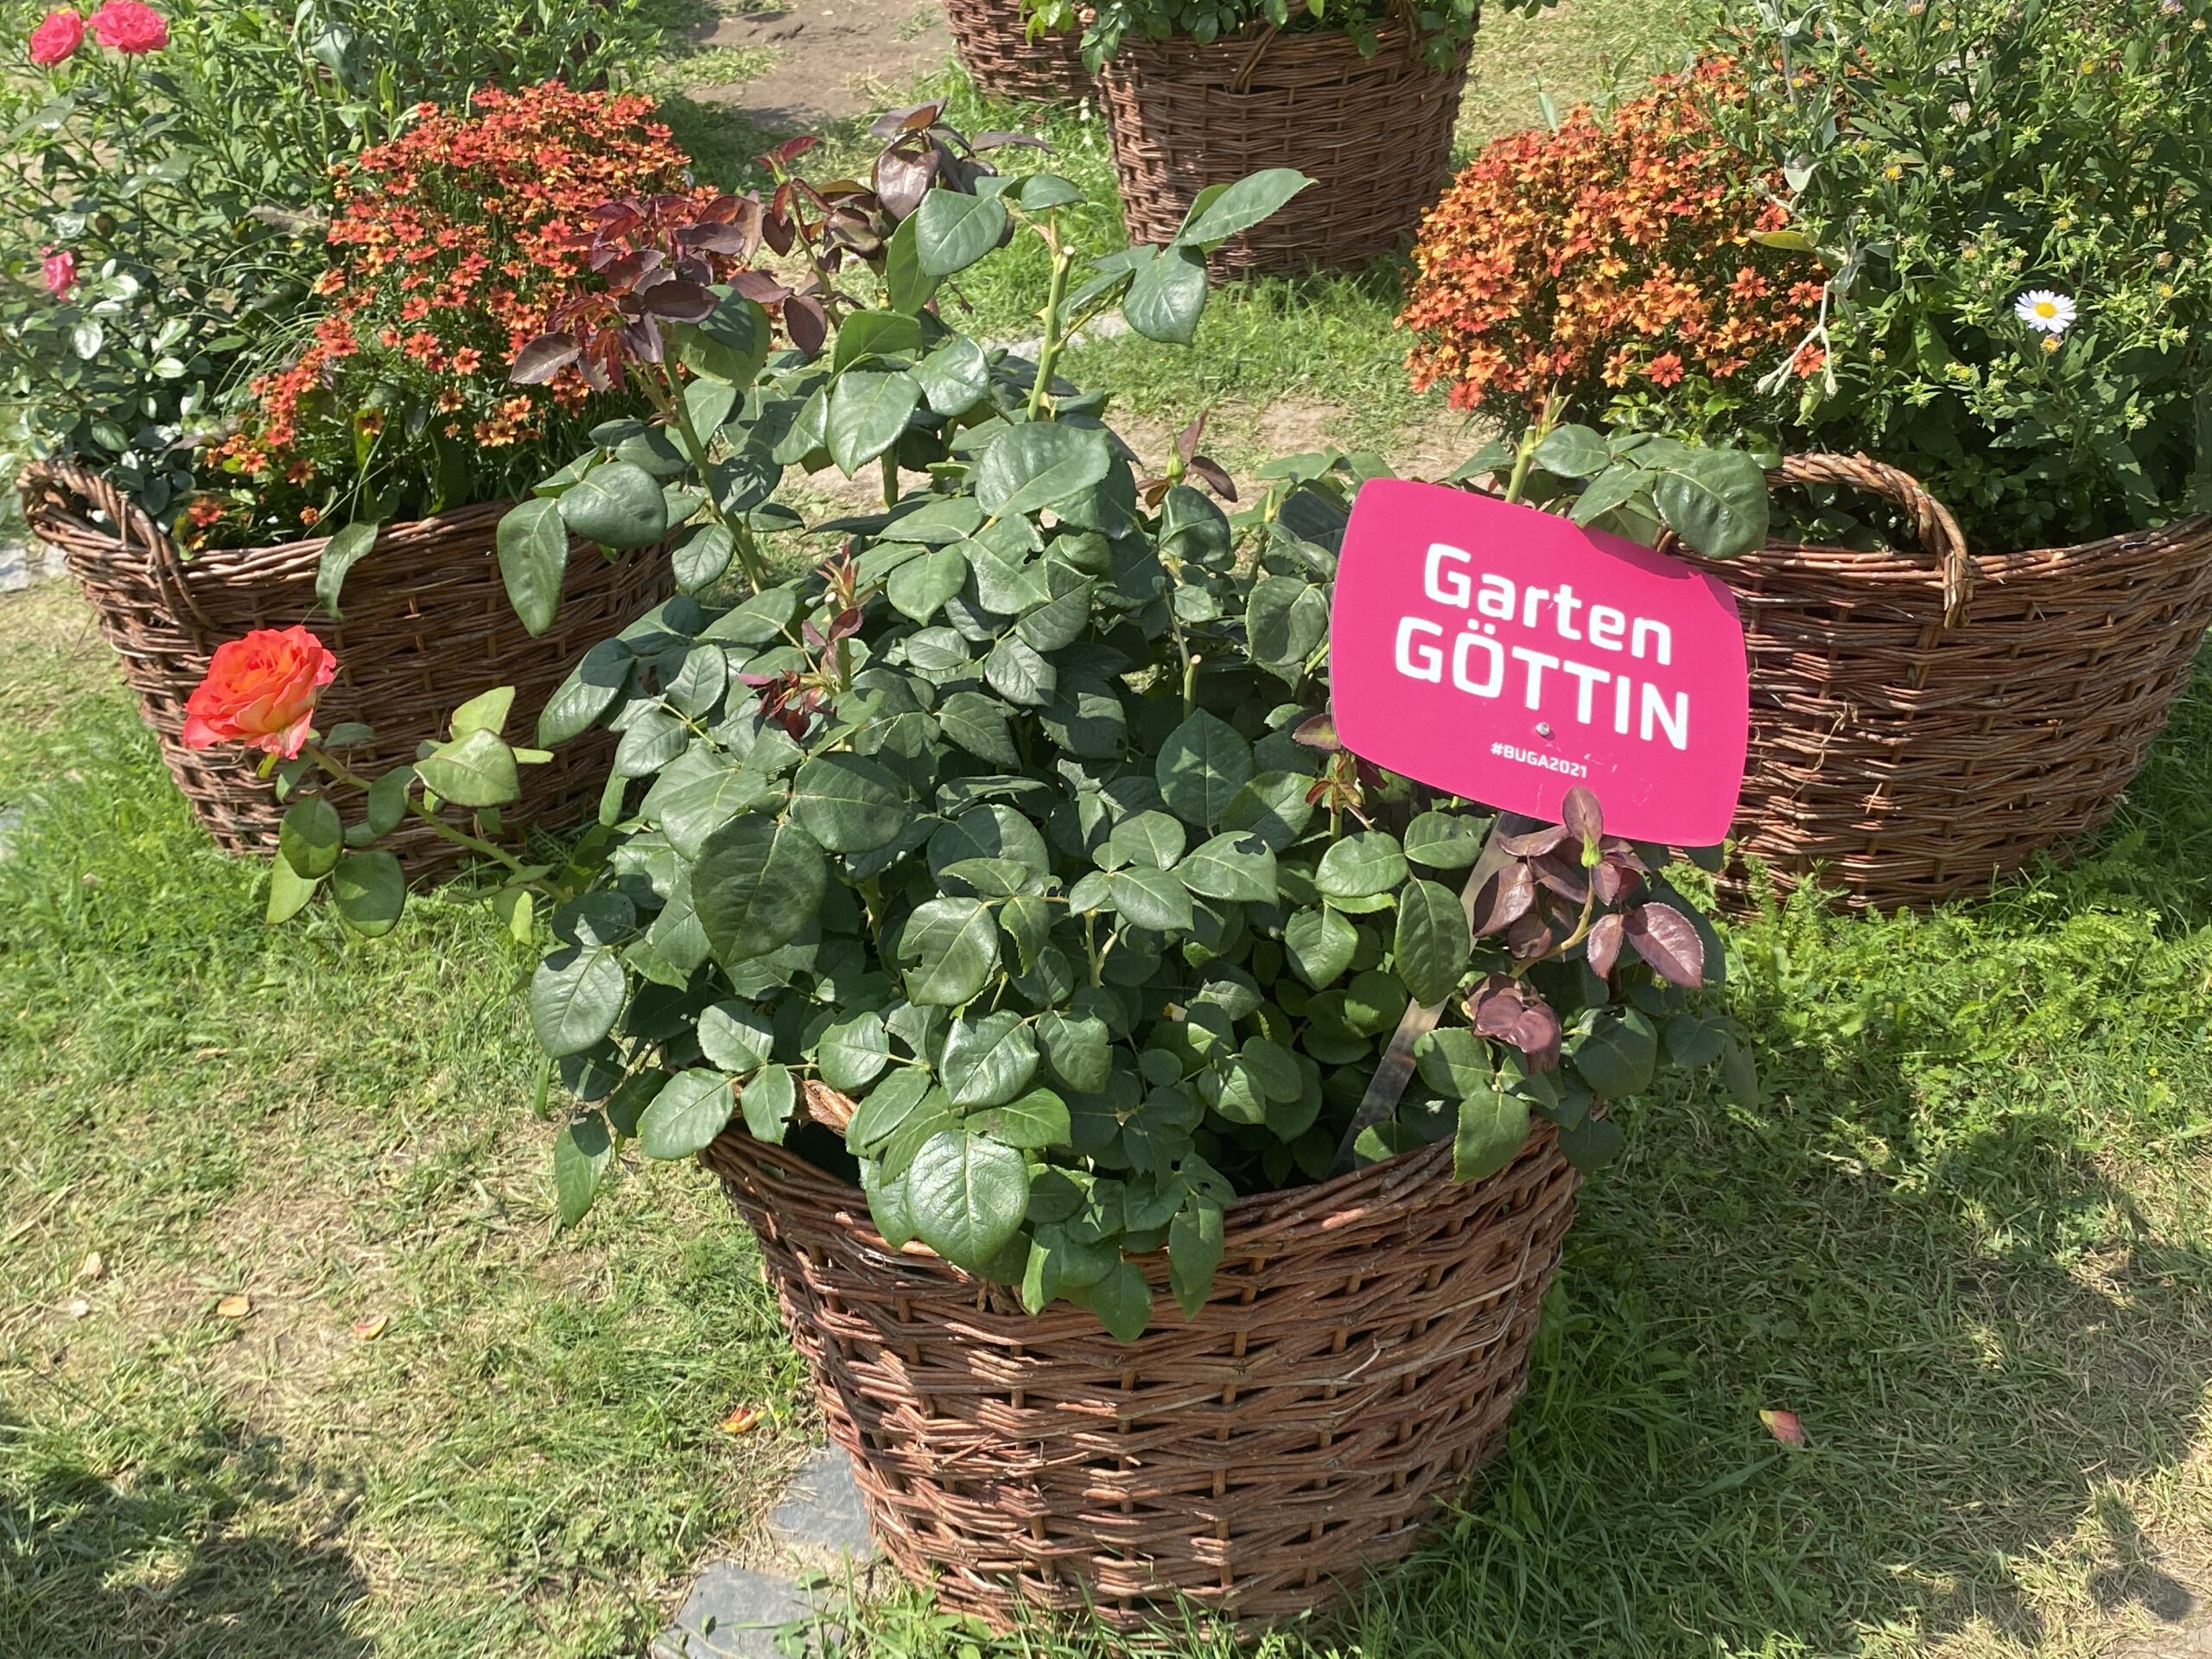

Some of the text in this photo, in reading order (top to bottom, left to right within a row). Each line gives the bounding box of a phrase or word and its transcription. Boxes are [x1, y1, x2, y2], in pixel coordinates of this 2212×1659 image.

[1423, 543, 1672, 666] Garten
[1395, 616, 1689, 751] GÖTTIN
[1490, 741, 1587, 779] #BUGA2021
